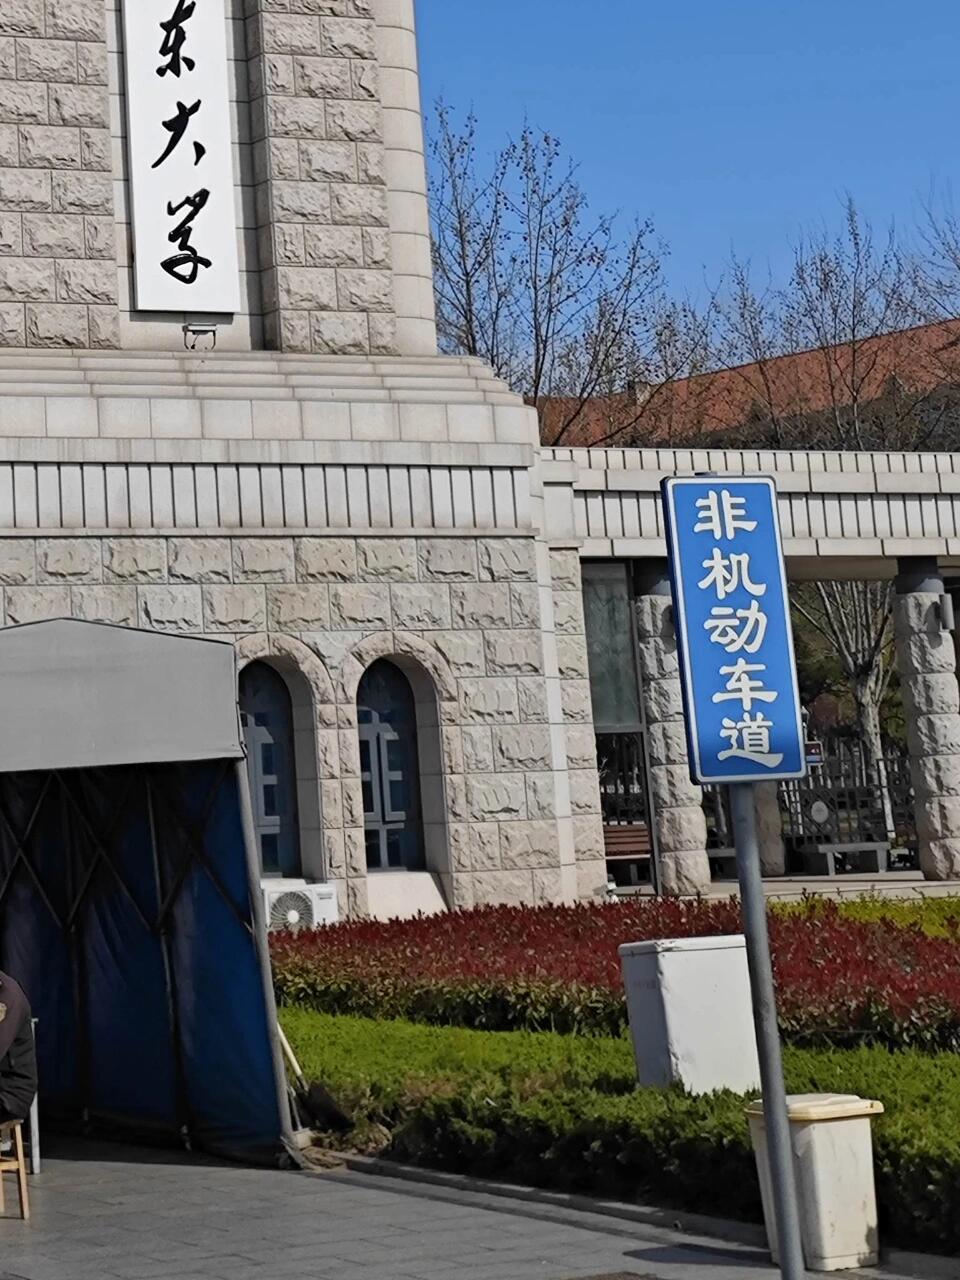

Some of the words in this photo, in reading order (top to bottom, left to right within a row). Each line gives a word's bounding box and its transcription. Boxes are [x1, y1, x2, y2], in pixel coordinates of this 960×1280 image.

[693, 489, 784, 769] 非机动车道
